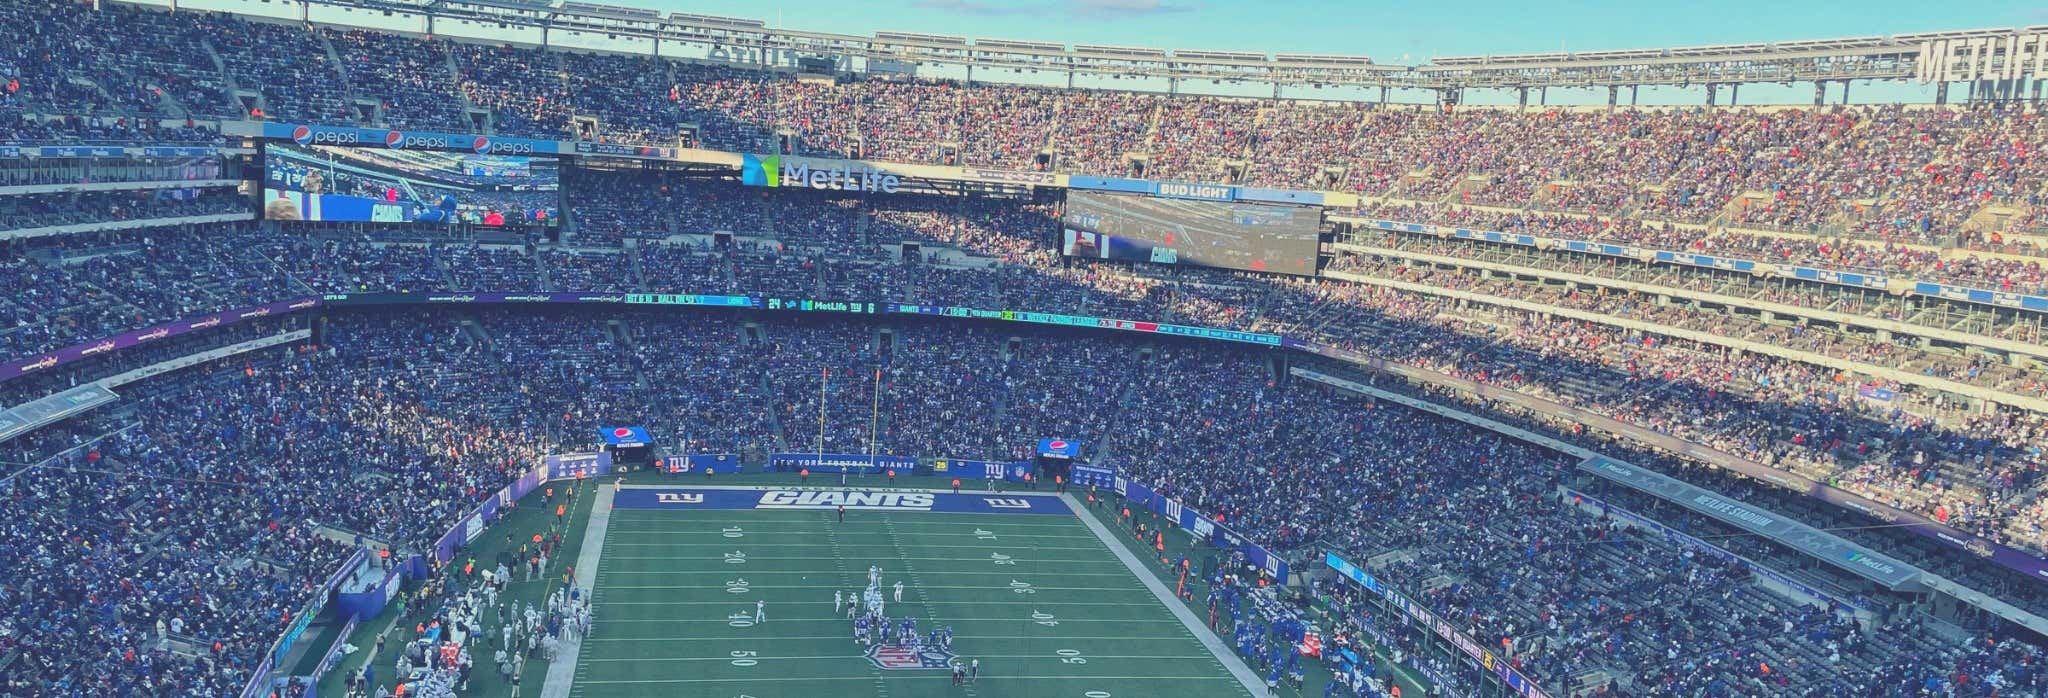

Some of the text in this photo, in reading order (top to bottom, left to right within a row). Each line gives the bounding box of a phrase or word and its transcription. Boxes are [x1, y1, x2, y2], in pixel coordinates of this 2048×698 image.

[1917, 34, 2048, 85] METLIFE
[314, 131, 359, 146] pepsi
[405, 135, 448, 150] pepsi
[491, 140, 534, 154] pepsi
[783, 162, 900, 193] MetLife
[1160, 184, 1229, 199] BUD LIGHT
[769, 299, 781, 309] 24
[814, 301, 847, 311] MetLife
[868, 303, 875, 313] 6
[799, 459, 822, 467] YORK
[757, 491, 935, 508] GIANTS
[1859, 556, 1895, 574] MetLife
[726, 581, 750, 593] 30
[728, 612, 754, 627] 40
[731, 650, 758, 666] 50
[1056, 649, 1087, 665] 50
